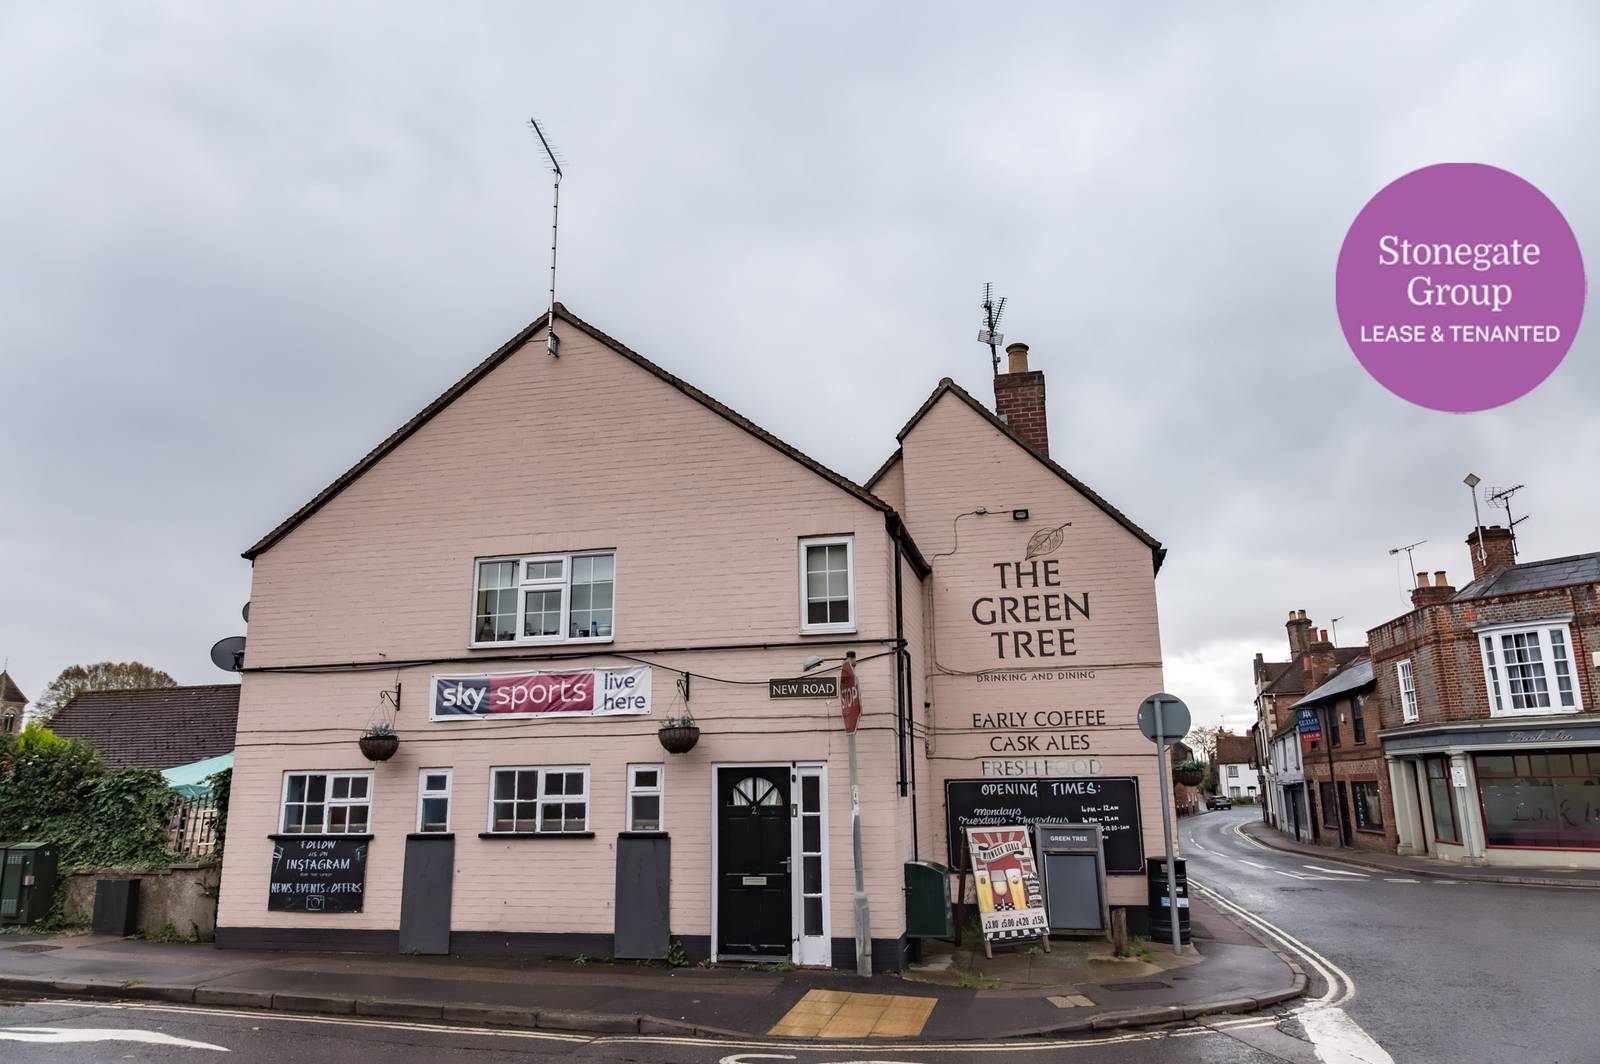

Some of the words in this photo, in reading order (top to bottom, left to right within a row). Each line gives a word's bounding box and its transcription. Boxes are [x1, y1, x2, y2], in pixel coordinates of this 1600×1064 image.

[993, 560, 1061, 589] THE
[972, 592, 1090, 625] GREEN
[991, 628, 1077, 659] TREE
[604, 672, 635, 690] live
[976, 673, 1027, 683] DRINKING
[1031, 672, 1053, 681] AND
[1058, 671, 1096, 680] DINING
[443, 682, 487, 711] sky
[496, 680, 587, 710] sports
[772, 684, 798, 695] NEW
[802, 683, 835, 694] ROAD
[603, 693, 646, 711] here
[841, 687, 858, 709] STOP
[973, 712, 1028, 729] EARLY
[1034, 710, 1106, 727] COFFEE
[990, 735, 1040, 752] CASK
[1046, 734, 1090, 751] ALES
[982, 760, 1037, 776] FRESH
[981, 783, 1038, 798] OPENING
[1051, 782, 1102, 796] TIMES:
[751, 806, 757, 815] 2
[958, 815, 1007, 826] Tuesdays
[301, 841, 336, 849] FOLLOW
[286, 859, 350, 871] INSTAGRAM
[296, 883, 326, 893] EVENTS
[331, 883, 362, 893] OFFERS
